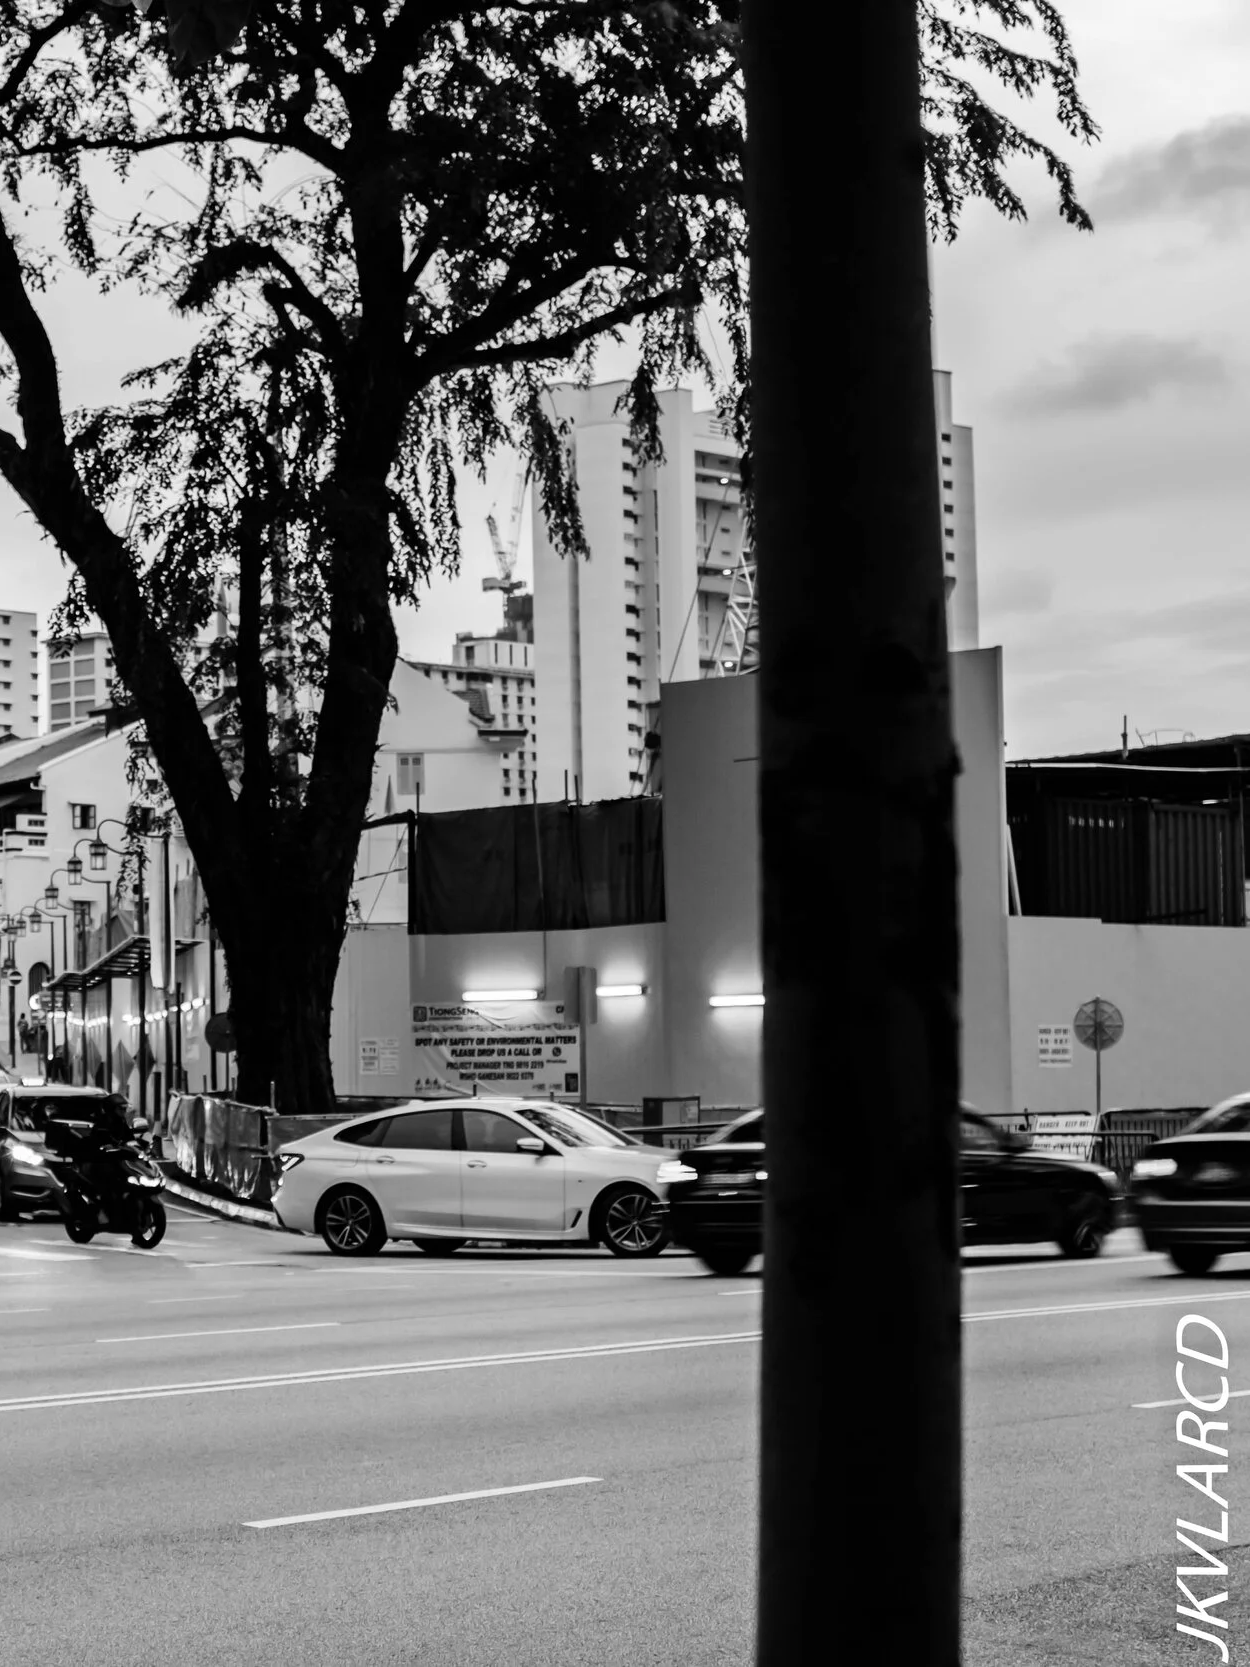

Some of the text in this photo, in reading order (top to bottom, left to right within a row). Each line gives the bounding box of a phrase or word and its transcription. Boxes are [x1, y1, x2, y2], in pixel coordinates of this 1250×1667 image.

[415, 1035, 577, 1047] SPOT ANY SAFETY OR ENVIRONMENTAL MATTERS
[450, 1048, 476, 1058] PLEASE
[476, 1048, 496, 1057] DROP
[496, 1048, 506, 1057] US
[513, 1047, 531, 1057] CALL
[531, 1047, 542, 1056] OR
